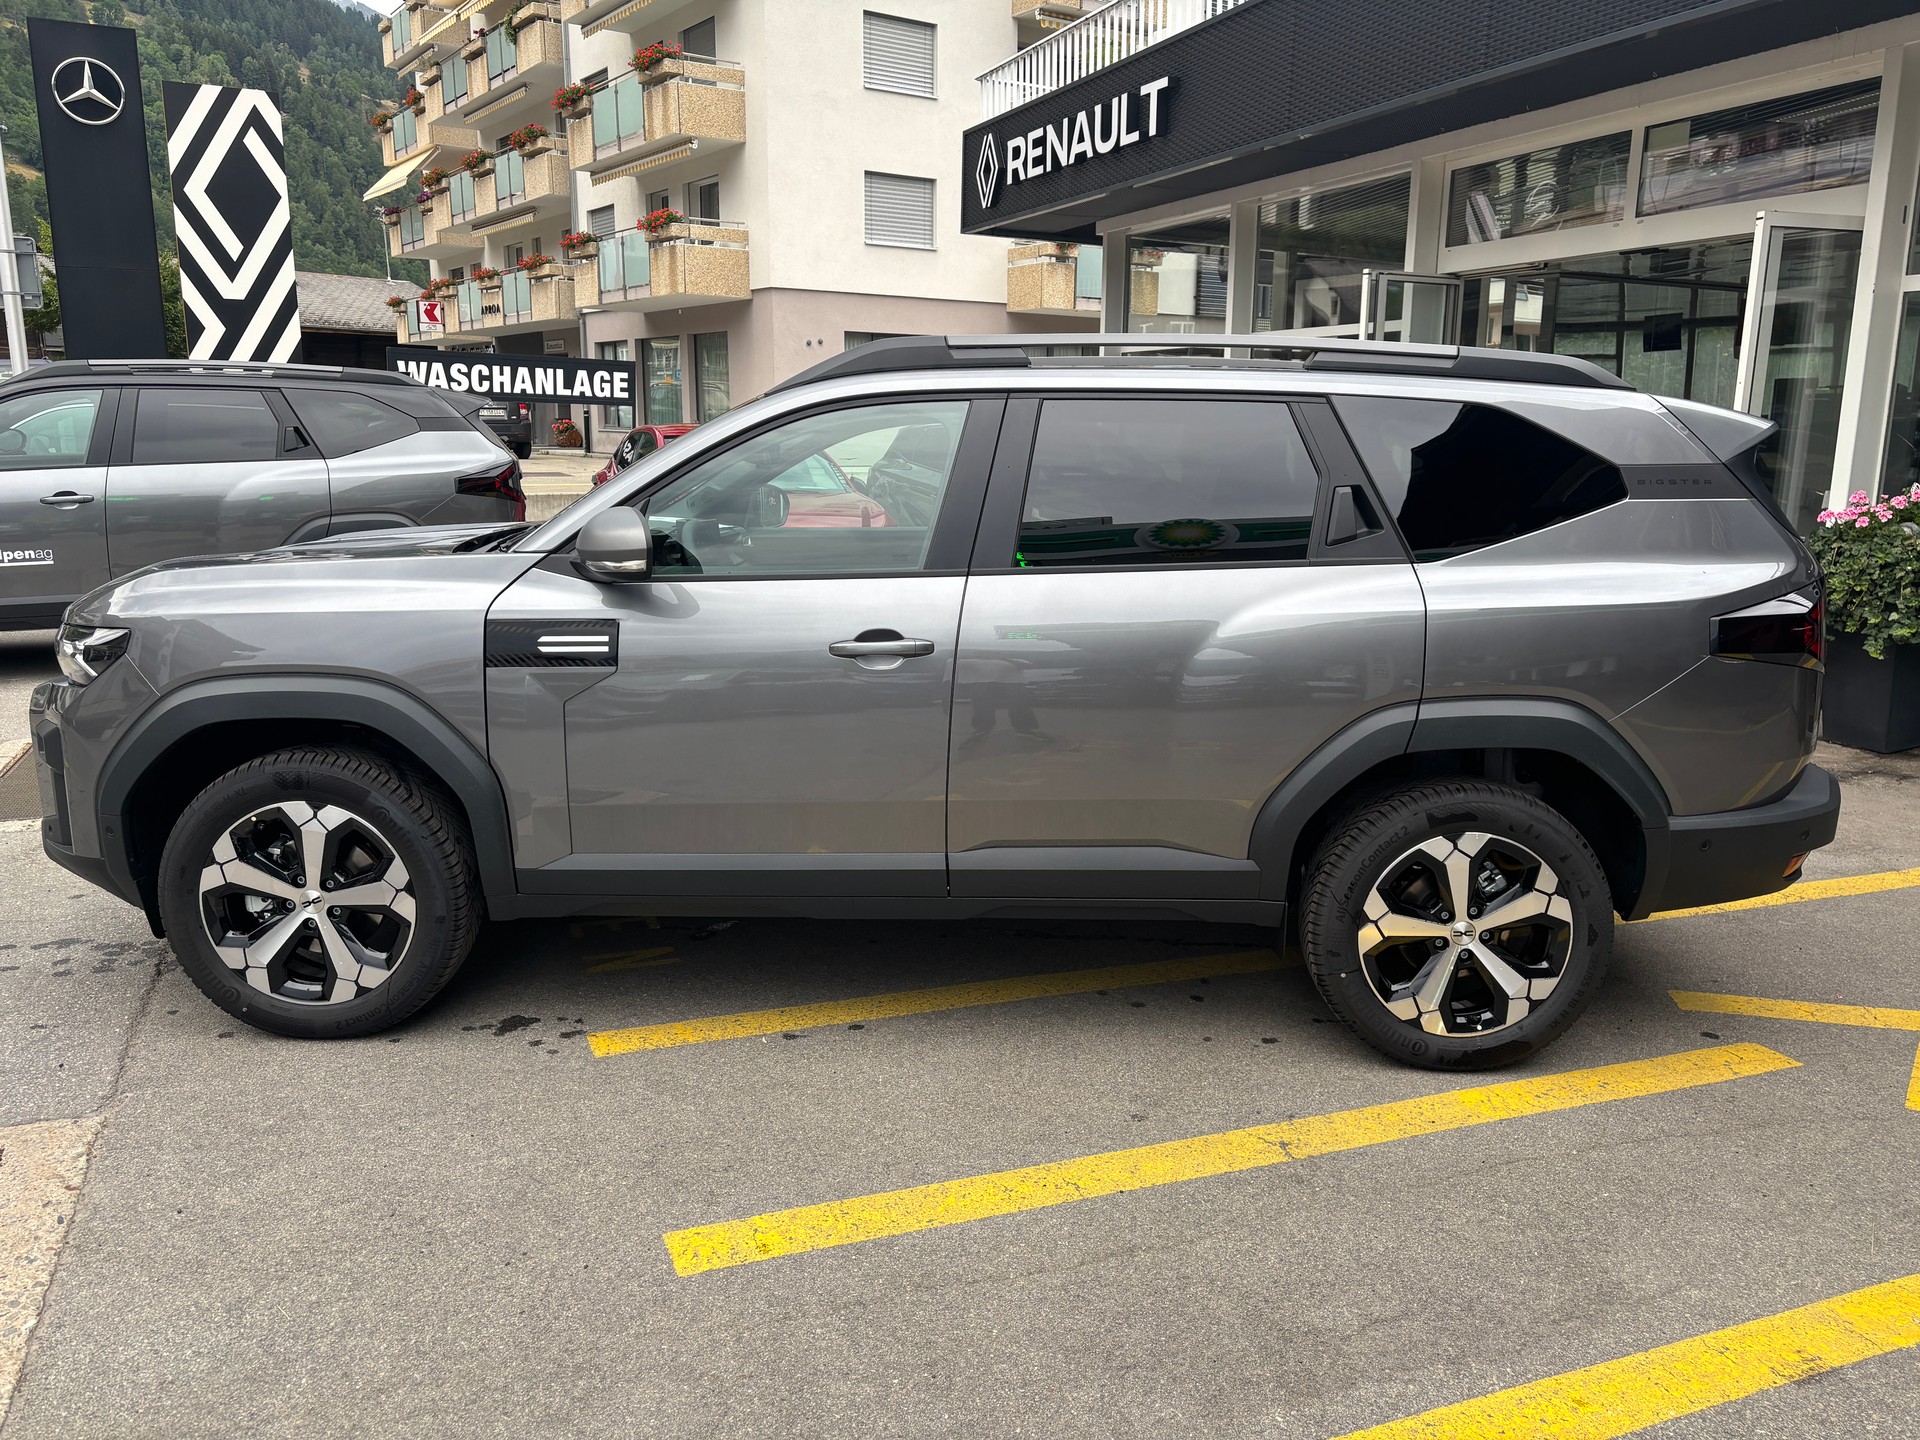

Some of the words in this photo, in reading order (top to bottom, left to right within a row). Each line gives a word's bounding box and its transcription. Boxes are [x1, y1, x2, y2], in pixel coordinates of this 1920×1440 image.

[1007, 76, 1169, 185] RENAULT
[396, 360, 629, 398] WASCHANLAGE
[1399, 824, 1410, 836] 2
